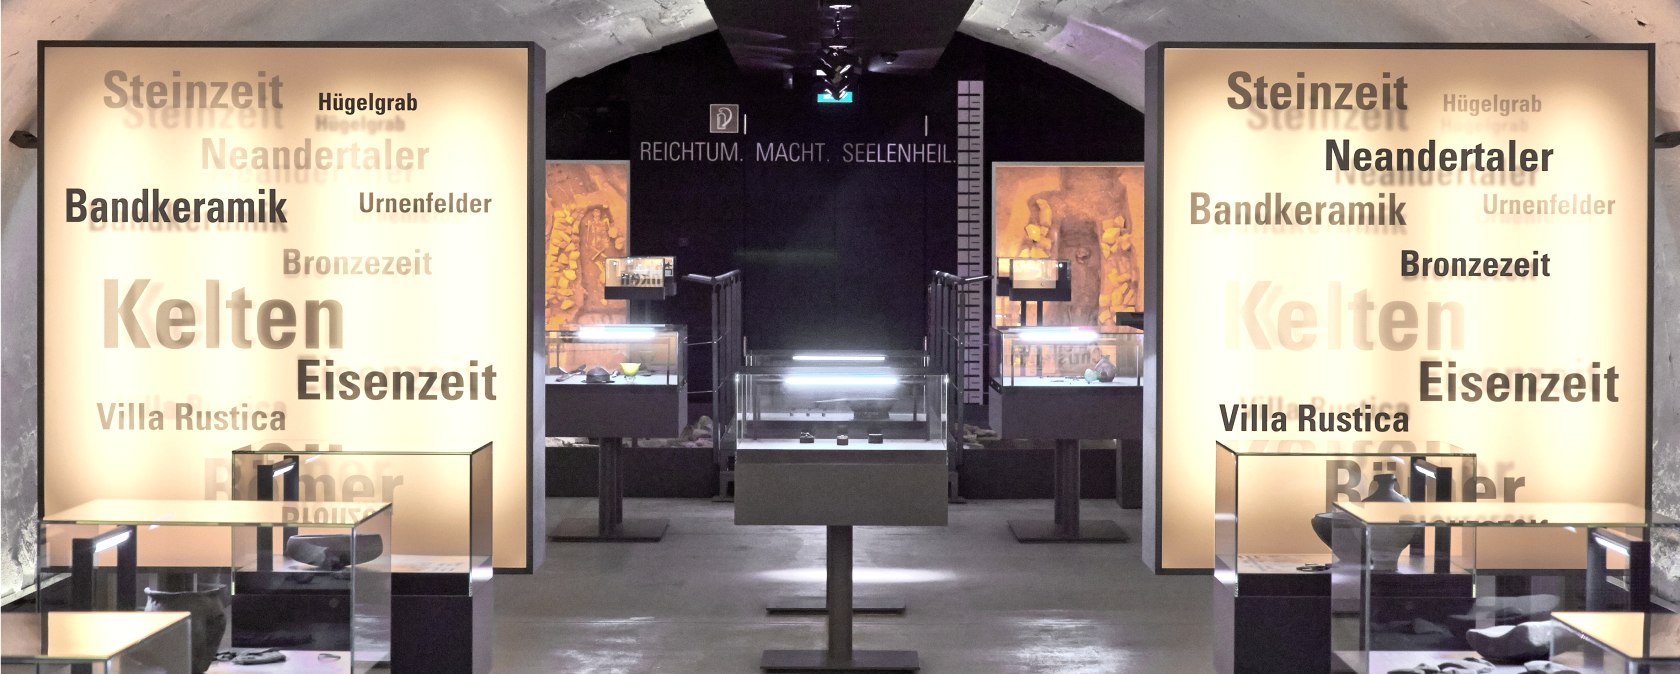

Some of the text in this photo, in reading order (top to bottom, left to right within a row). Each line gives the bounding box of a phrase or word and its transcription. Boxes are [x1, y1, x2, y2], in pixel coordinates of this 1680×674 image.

[103, 69, 284, 110] Steinzeit
[318, 92, 418, 115] Hügelgrab
[1227, 71, 1409, 111] Steinzeit
[1443, 94, 1542, 117] Hügelgrab
[201, 137, 430, 171] Neandertaler
[640, 141, 957, 164] REICHTUM. MACHT. SEELENHEIL.
[1325, 139, 1554, 172] Neandertaler
[65, 188, 288, 224] Bandkeramik
[359, 192, 493, 214] Urnenfelder
[1190, 192, 1407, 226] Bandkeramik
[1483, 193, 1616, 215] Urnenfelder
[283, 248, 433, 276] Bronzezeit
[1401, 249, 1551, 277] Bronzezeit
[103, 278, 344, 349] Kelten
[1226, 280, 1465, 351] Kelten
[298, 359, 497, 401] Eisenzeit
[1419, 361, 1619, 402] Eisenzeit
[97, 402, 287, 431] Villa Rustica
[1220, 403, 1410, 432] Villa Rustica
